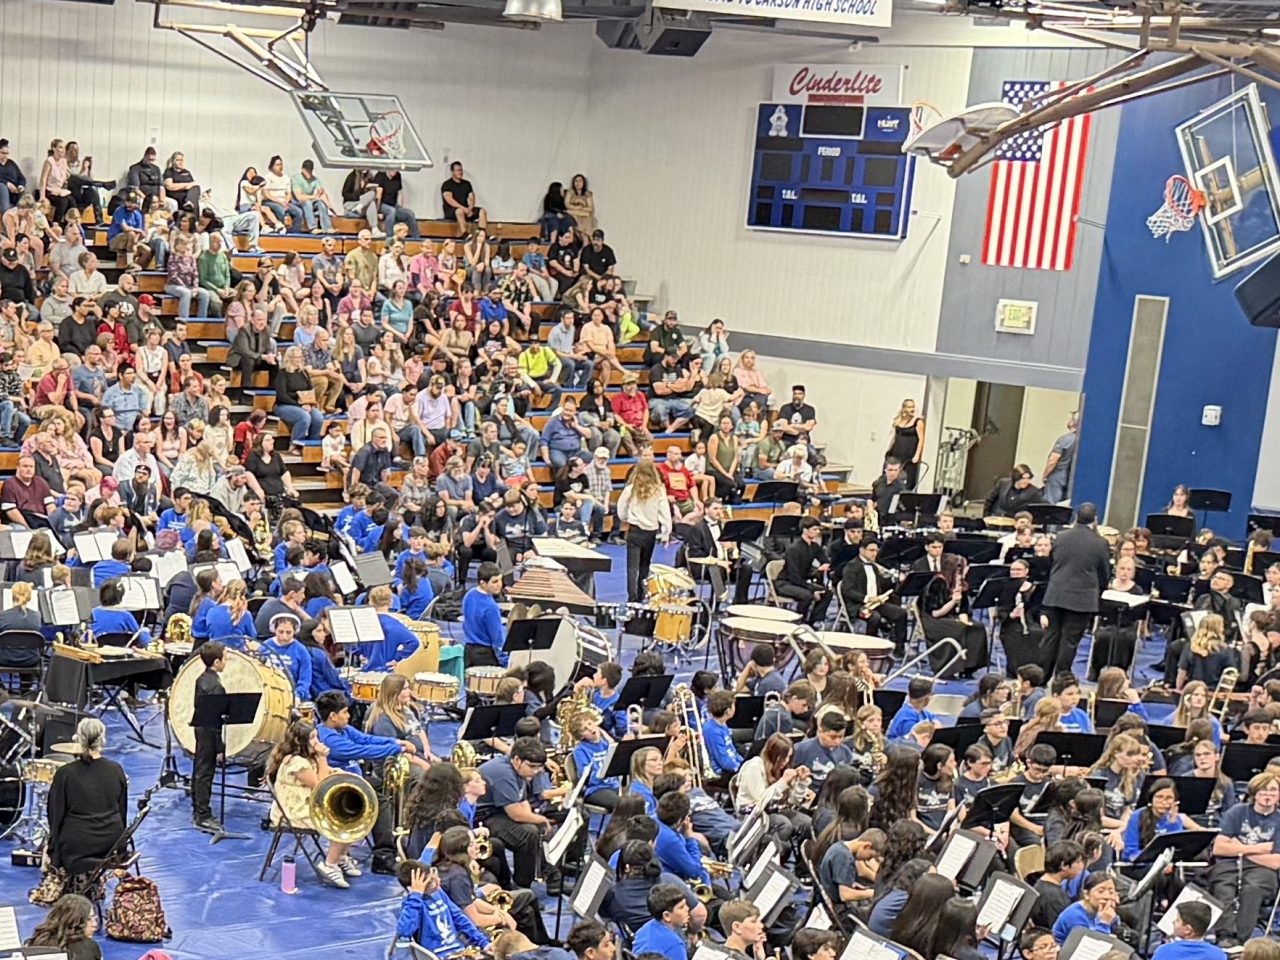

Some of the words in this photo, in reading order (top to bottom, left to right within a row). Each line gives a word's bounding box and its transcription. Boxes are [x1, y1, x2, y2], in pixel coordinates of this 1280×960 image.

[801, 0, 832, 11] HIGH
[833, 0, 878, 15] SCHOOL
[789, 66, 882, 96] Cinderlite
